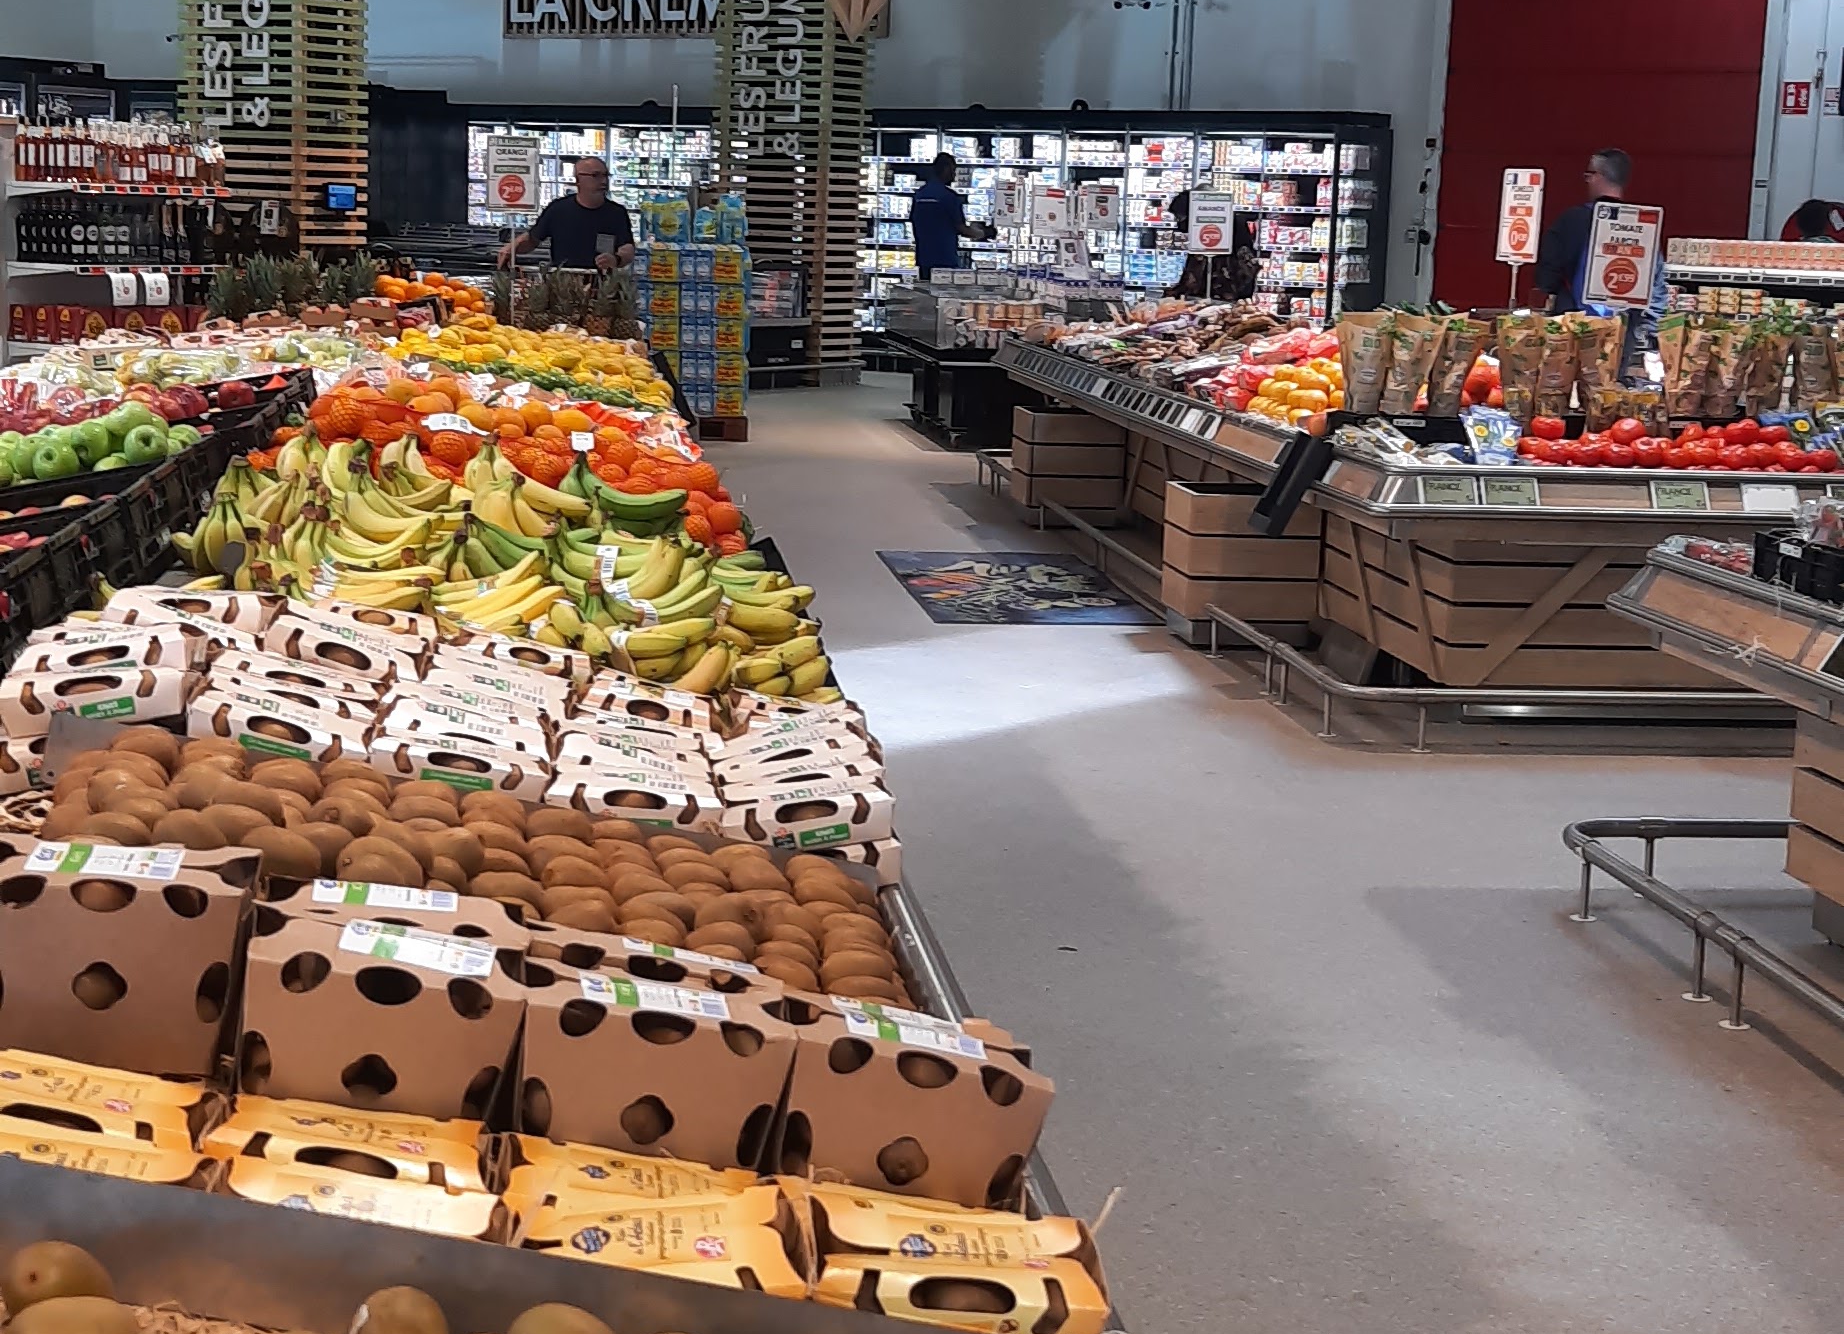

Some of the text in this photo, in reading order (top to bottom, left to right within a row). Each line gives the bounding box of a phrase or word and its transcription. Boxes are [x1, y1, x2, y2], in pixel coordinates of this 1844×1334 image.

[202, 38, 234, 127] LES
[241, 96, 270, 127] &
[737, 86, 768, 156] LES
[772, 131, 801, 157] &
